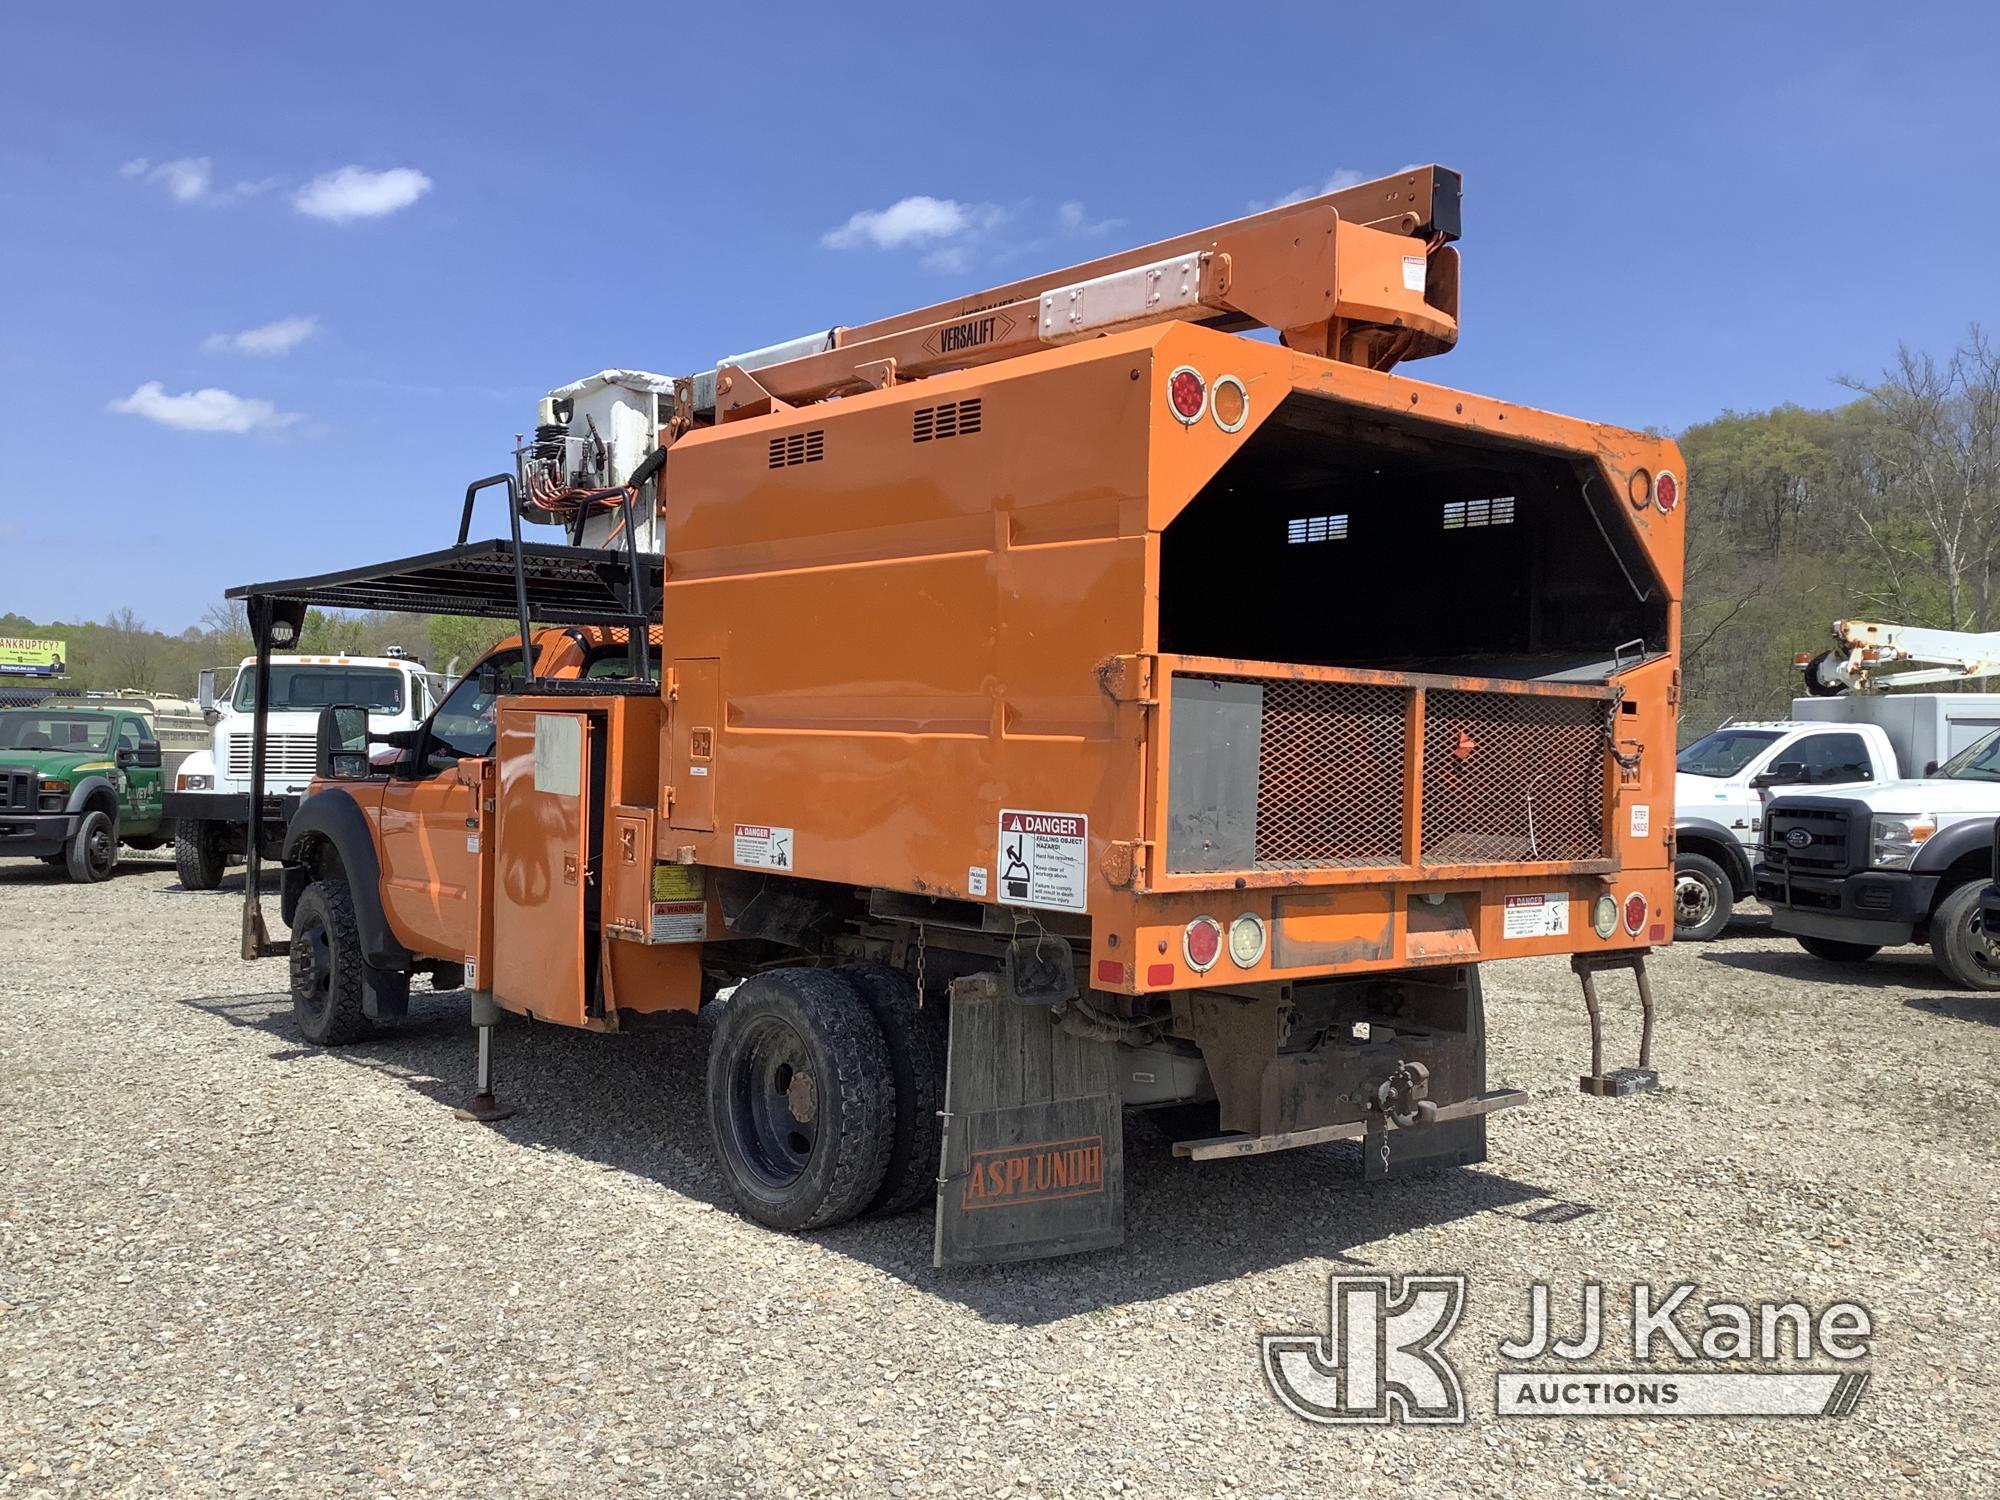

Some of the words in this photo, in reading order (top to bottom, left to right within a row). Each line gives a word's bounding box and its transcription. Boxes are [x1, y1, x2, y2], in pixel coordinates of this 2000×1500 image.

[941, 317, 996, 353] VERSALIFT
[1025, 816, 1077, 834] DANGER
[744, 827, 769, 838] DANGER
[1516, 896, 1543, 906] DANGER
[667, 904, 701, 913] WARNING
[966, 1146, 1101, 1200] ASPLUNDH
